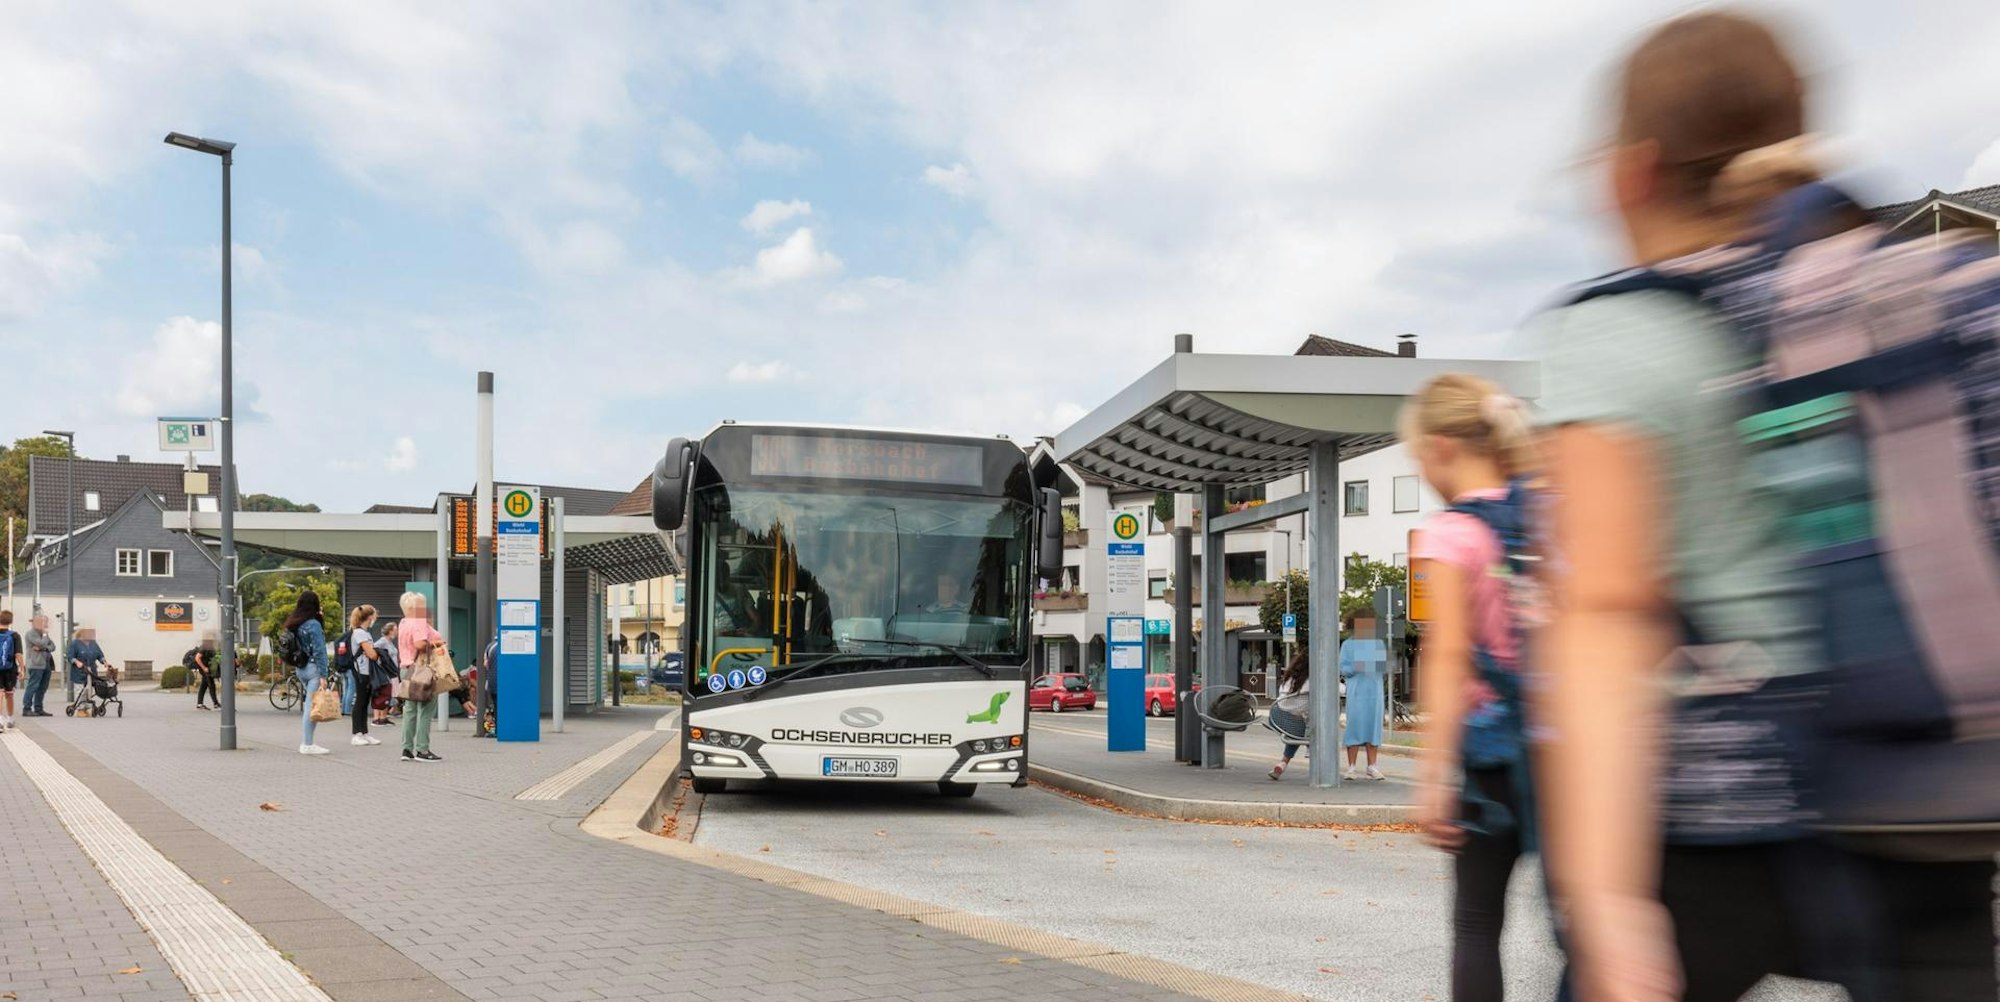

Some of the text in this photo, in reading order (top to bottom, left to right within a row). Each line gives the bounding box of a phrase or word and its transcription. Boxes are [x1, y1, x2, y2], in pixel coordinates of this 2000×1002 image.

[512, 496, 525, 512] H
[1120, 519, 1132, 534] H
[1285, 616, 1294, 626] P
[771, 728, 952, 745] OCHSENBRÜCHER
[831, 760, 848, 773] GM
[873, 762, 896, 774] 389
